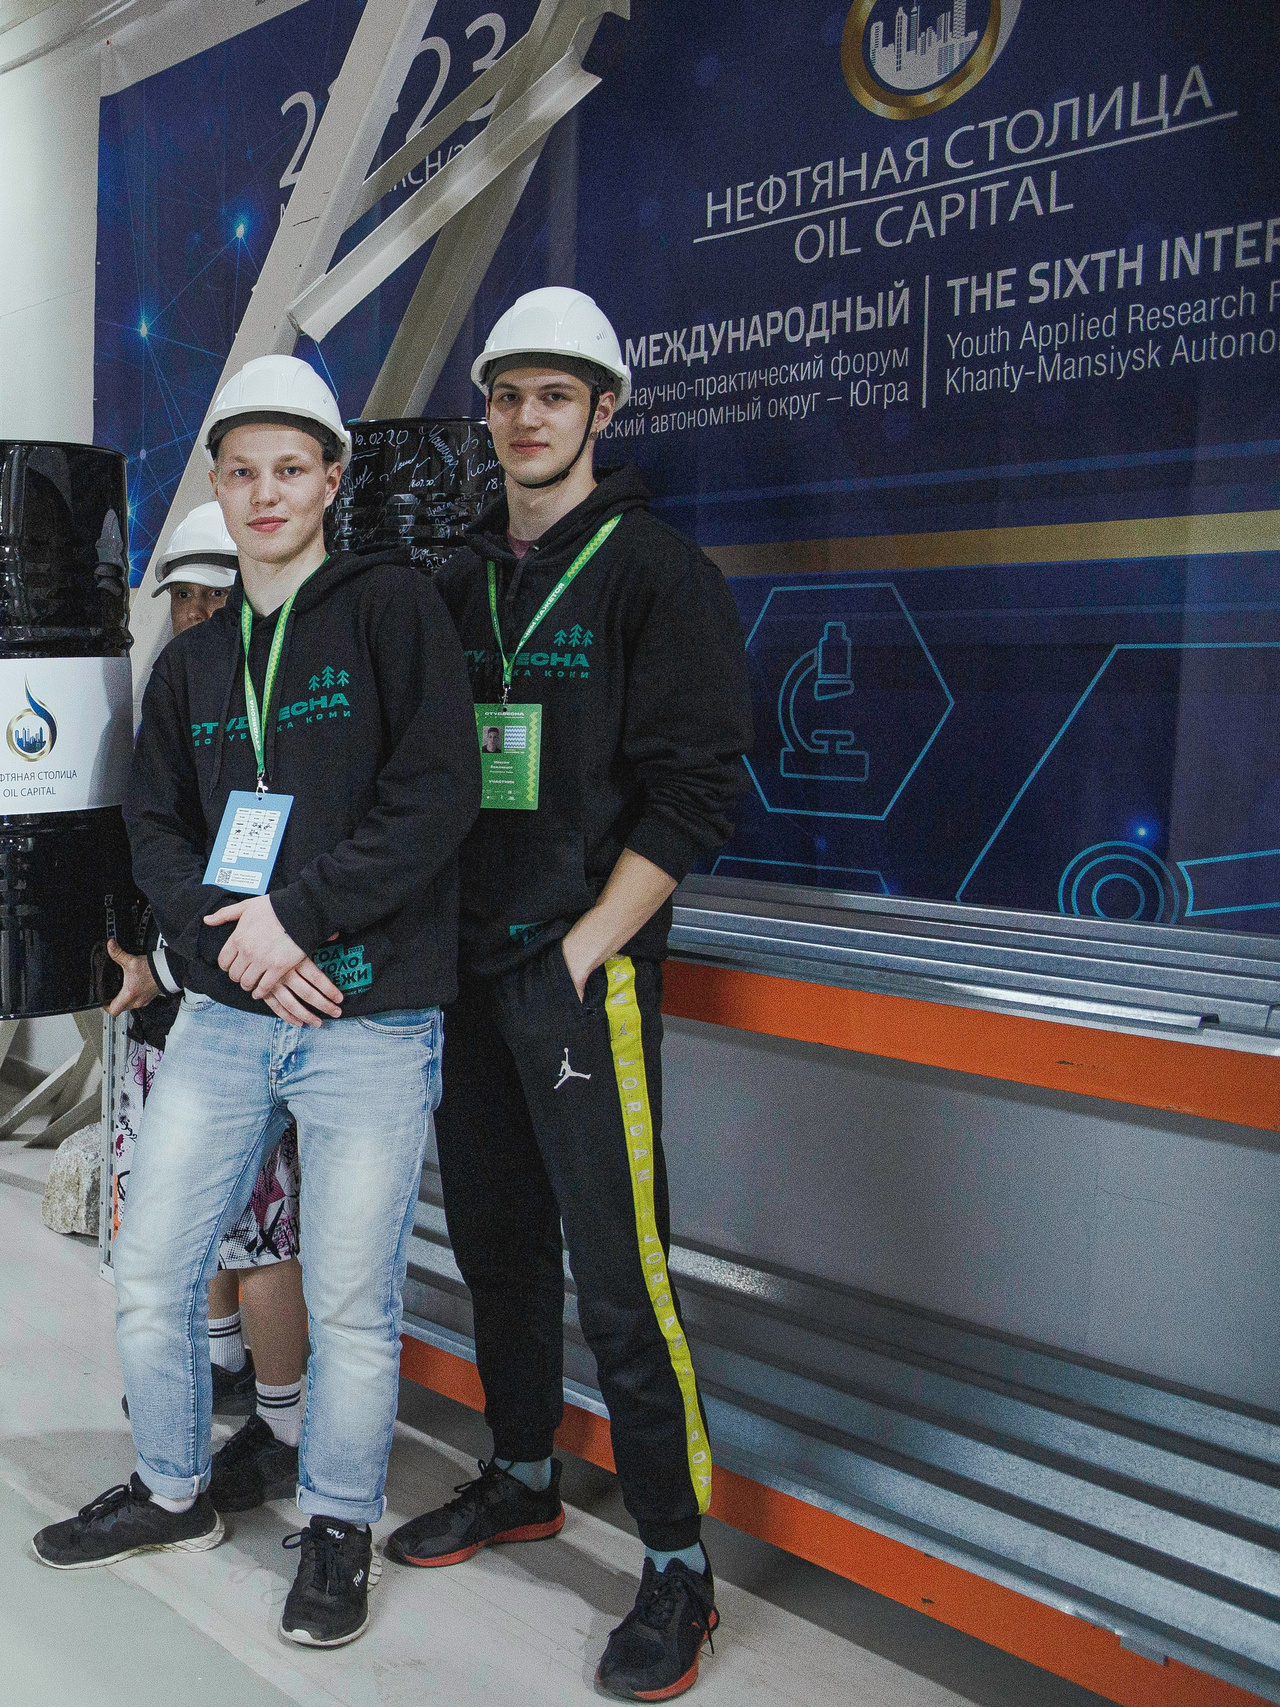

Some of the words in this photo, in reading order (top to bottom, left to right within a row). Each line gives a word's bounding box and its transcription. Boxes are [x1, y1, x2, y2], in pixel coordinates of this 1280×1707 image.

[706, 137, 929, 228] НЕФТЯНАЯ
[943, 65, 1214, 170] СТОЛИЦА
[794, 216, 861, 264] OIL
[875, 171, 1074, 248] CAPITAL
[946, 267, 1017, 317] THE
[1029, 245, 1143, 304] SIXTH
[625, 280, 910, 368] МЕЖДУНАРОДНЫЙ
[947, 317, 1011, 361] Youth
[1020, 307, 1117, 355] Applied
[1128, 286, 1255, 334] Research
[628, 354, 823, 407] научно-практический
[831, 347, 908, 381] форум
[946, 339, 1162, 395] Khanty-Mansiysk
[1170, 329, 1280, 366] Autono
[650, 397, 761, 434] автономный
[768, 392, 821, 424] округ
[850, 379, 908, 409] Югра
[544, 669, 589, 679] КОМИ
[306, 710, 351, 723] КОМИ
[2, 788, 18, 798] OIL
[20, 786, 56, 797] CAPITAL
[37, 769, 77, 781] СТОЛИЦА
